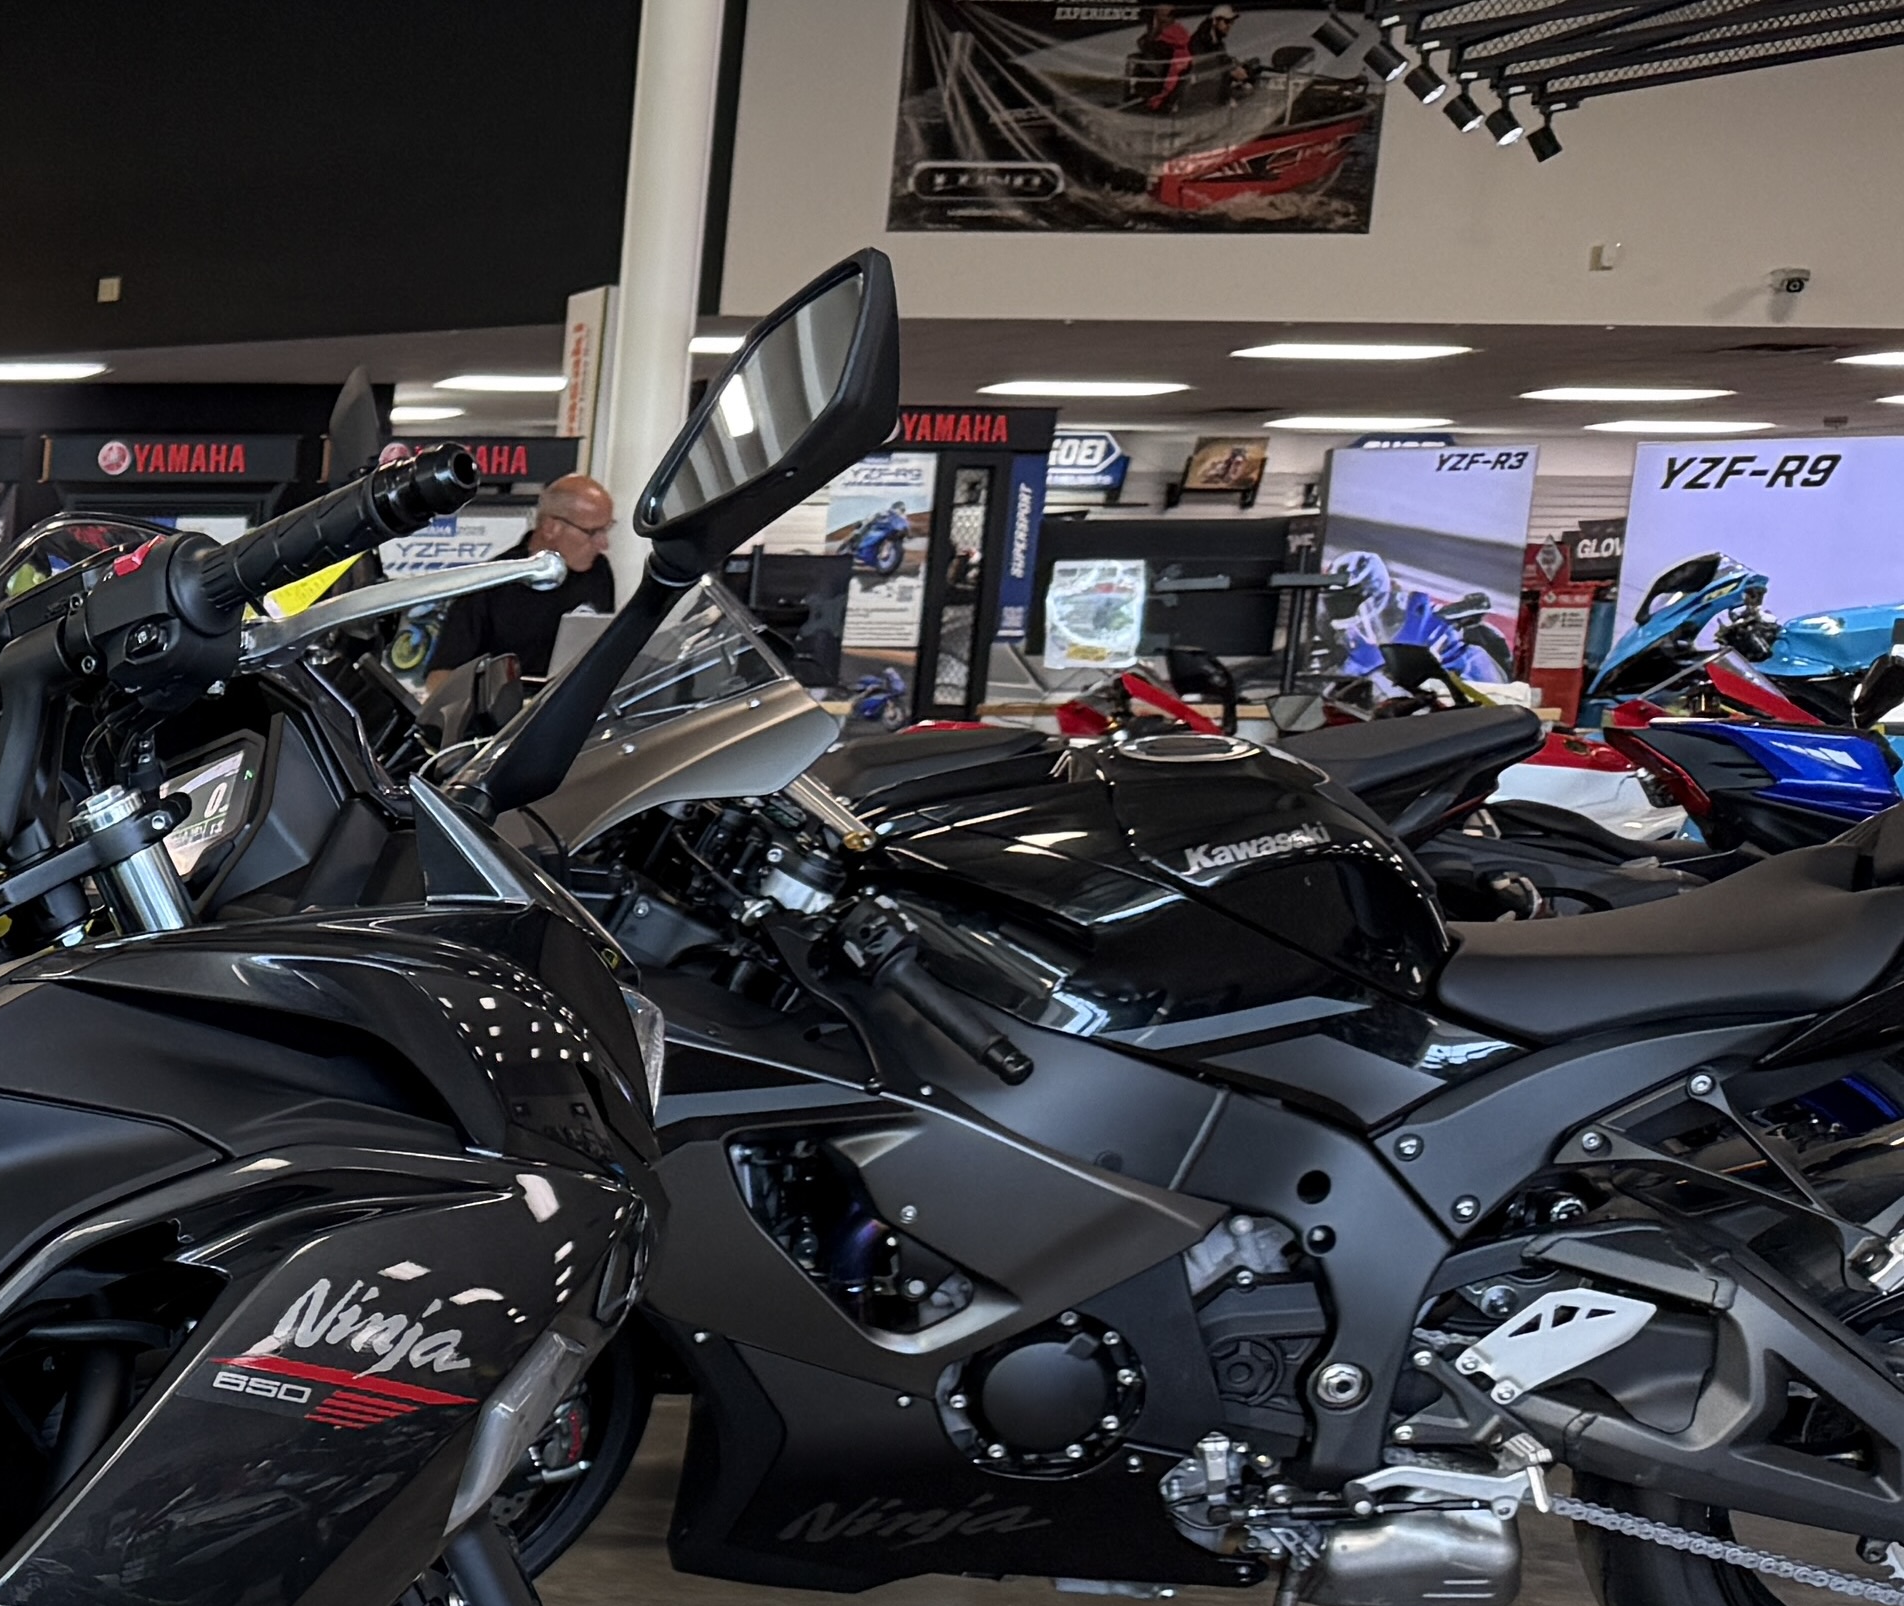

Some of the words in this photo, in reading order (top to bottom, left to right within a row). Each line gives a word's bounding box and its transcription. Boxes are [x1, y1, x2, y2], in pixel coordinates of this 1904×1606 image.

[902, 413, 1008, 443] YAMAHA
[134, 443, 247, 473] YAMAHA
[1435, 451, 1529, 472] YZF-R3
[1658, 453, 1843, 490] YZF-R9
[1010, 482, 1034, 579] SUPERSPORT
[396, 542, 493, 558] YZF-R7
[1185, 820, 1332, 874] Kawasaki
[273, 1278, 471, 1380] Ninja
[213, 1370, 312, 1405] 650
[778, 1494, 1052, 1551] Ninja
